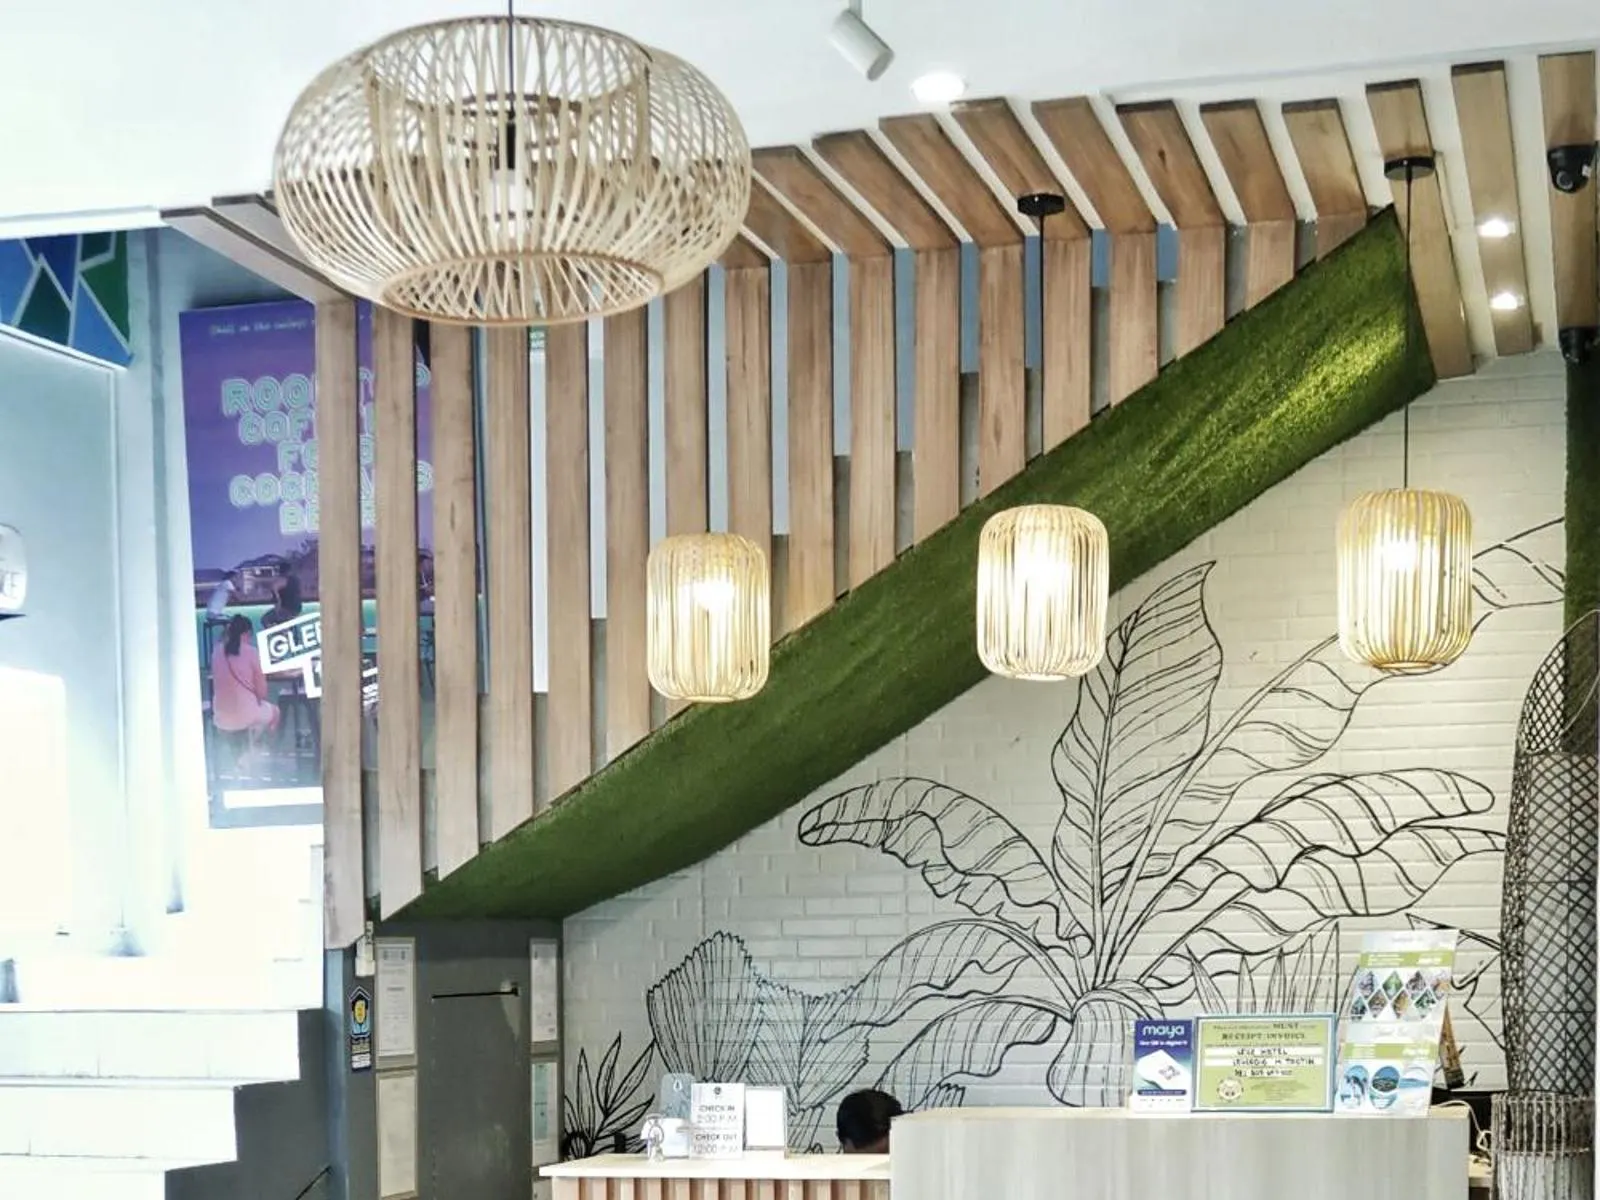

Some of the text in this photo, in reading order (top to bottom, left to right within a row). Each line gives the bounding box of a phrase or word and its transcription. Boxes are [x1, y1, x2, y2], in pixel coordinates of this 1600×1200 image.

[269, 622, 321, 659] GLE
[1142, 1025, 1185, 1039] maya
[695, 1133, 720, 1141] CHECK
